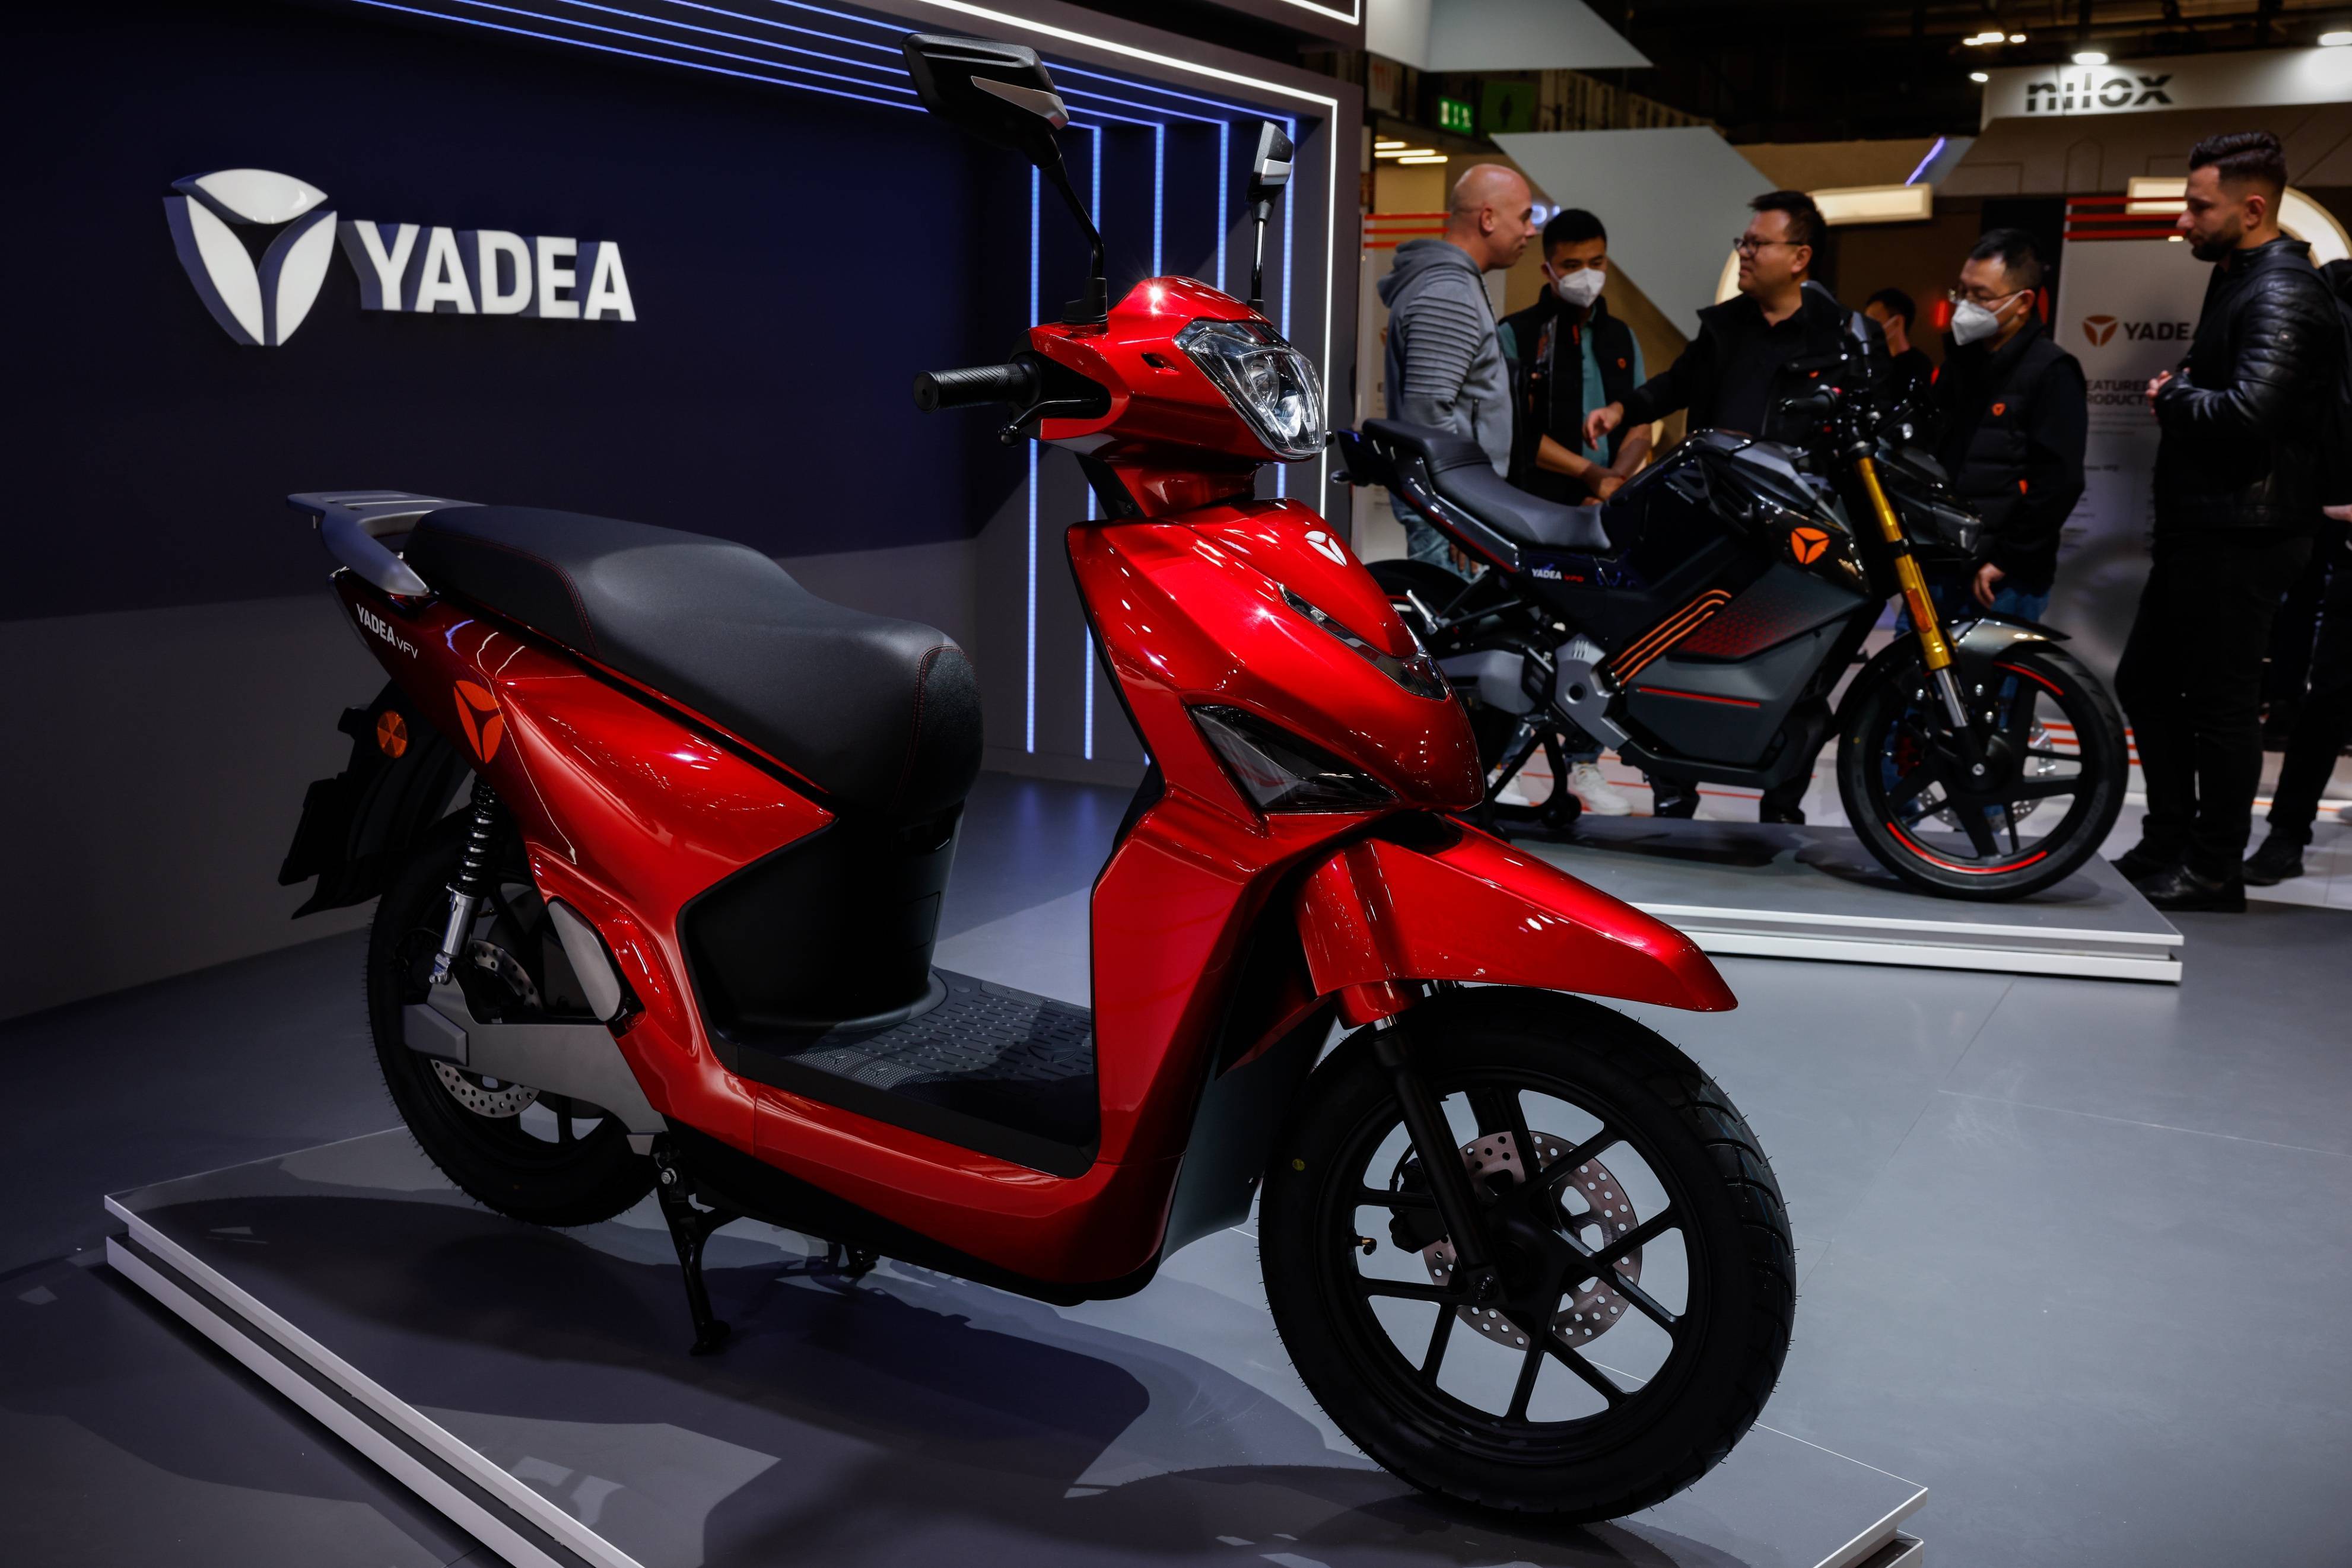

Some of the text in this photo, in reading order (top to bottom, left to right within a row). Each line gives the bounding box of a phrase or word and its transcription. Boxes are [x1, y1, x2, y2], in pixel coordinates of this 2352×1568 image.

[2027, 72, 2172, 112] nilox
[354, 220, 637, 322] YADEA
[2124, 322, 2195, 341] YADE
[1531, 568, 1562, 580] YADEA
[356, 603, 418, 659] YADEA VFV
